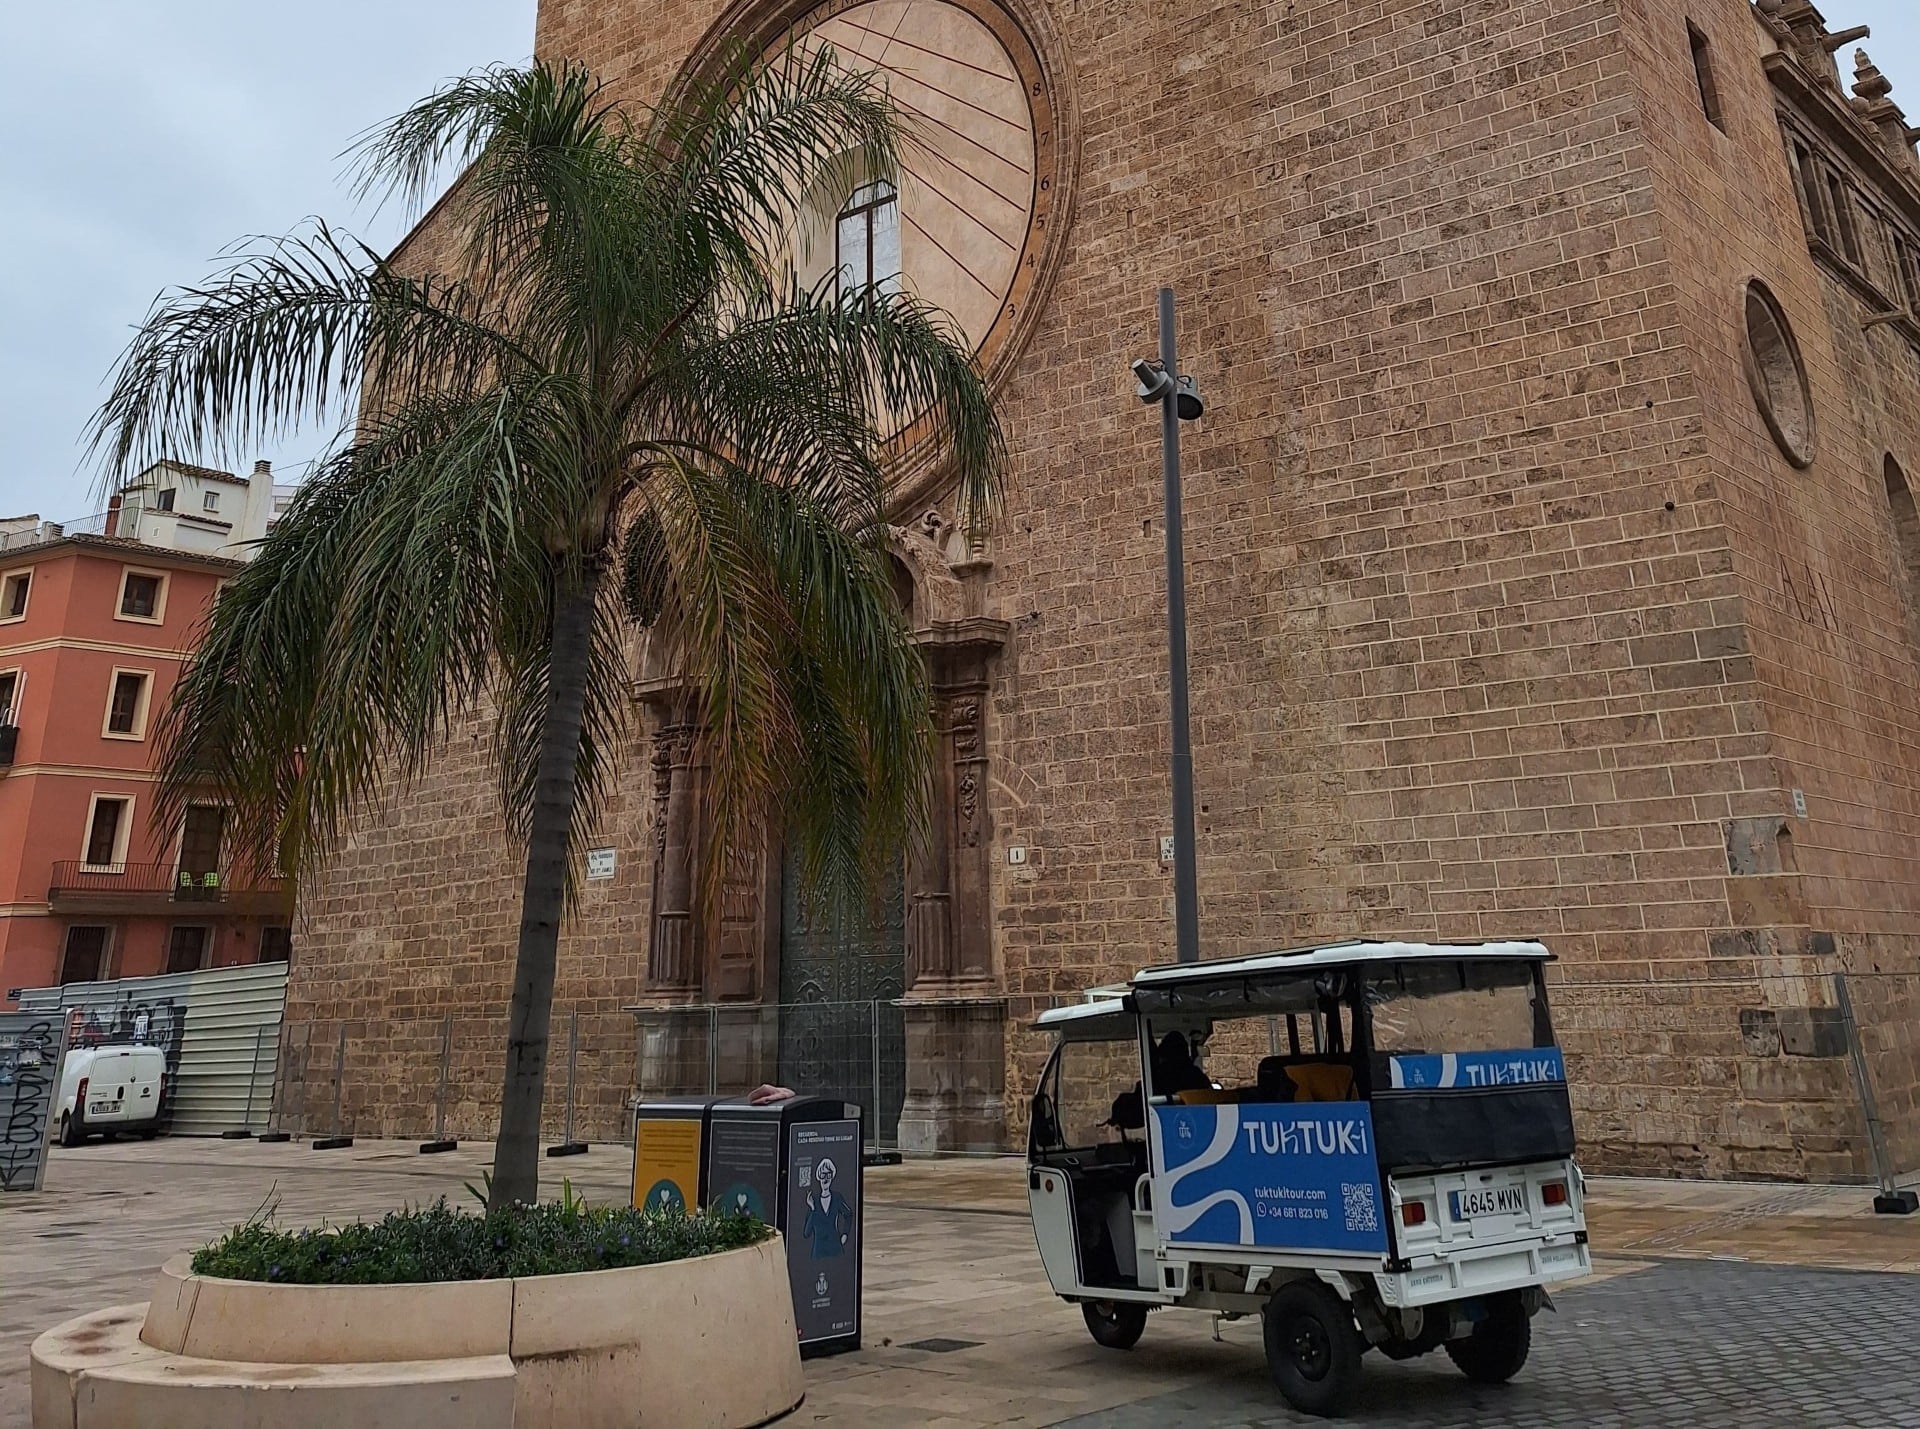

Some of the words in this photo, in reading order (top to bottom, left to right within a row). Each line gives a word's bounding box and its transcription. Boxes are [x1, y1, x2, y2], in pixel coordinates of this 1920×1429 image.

[1032, 82, 1041, 96] 8
[1040, 131, 1050, 146] 7
[1040, 174, 1050, 190] 6
[1036, 213, 1045, 230] 5
[1026, 253, 1035, 268] 4
[1007, 303, 1016, 319] 3
[1463, 1192, 1495, 1215] 4645
[1497, 1188, 1522, 1210] MVN
[1269, 1207, 1282, 1217] +34
[1283, 1207, 1297, 1218] 681
[1299, 1208, 1313, 1219] 823
[1314, 1208, 1329, 1220] 016
